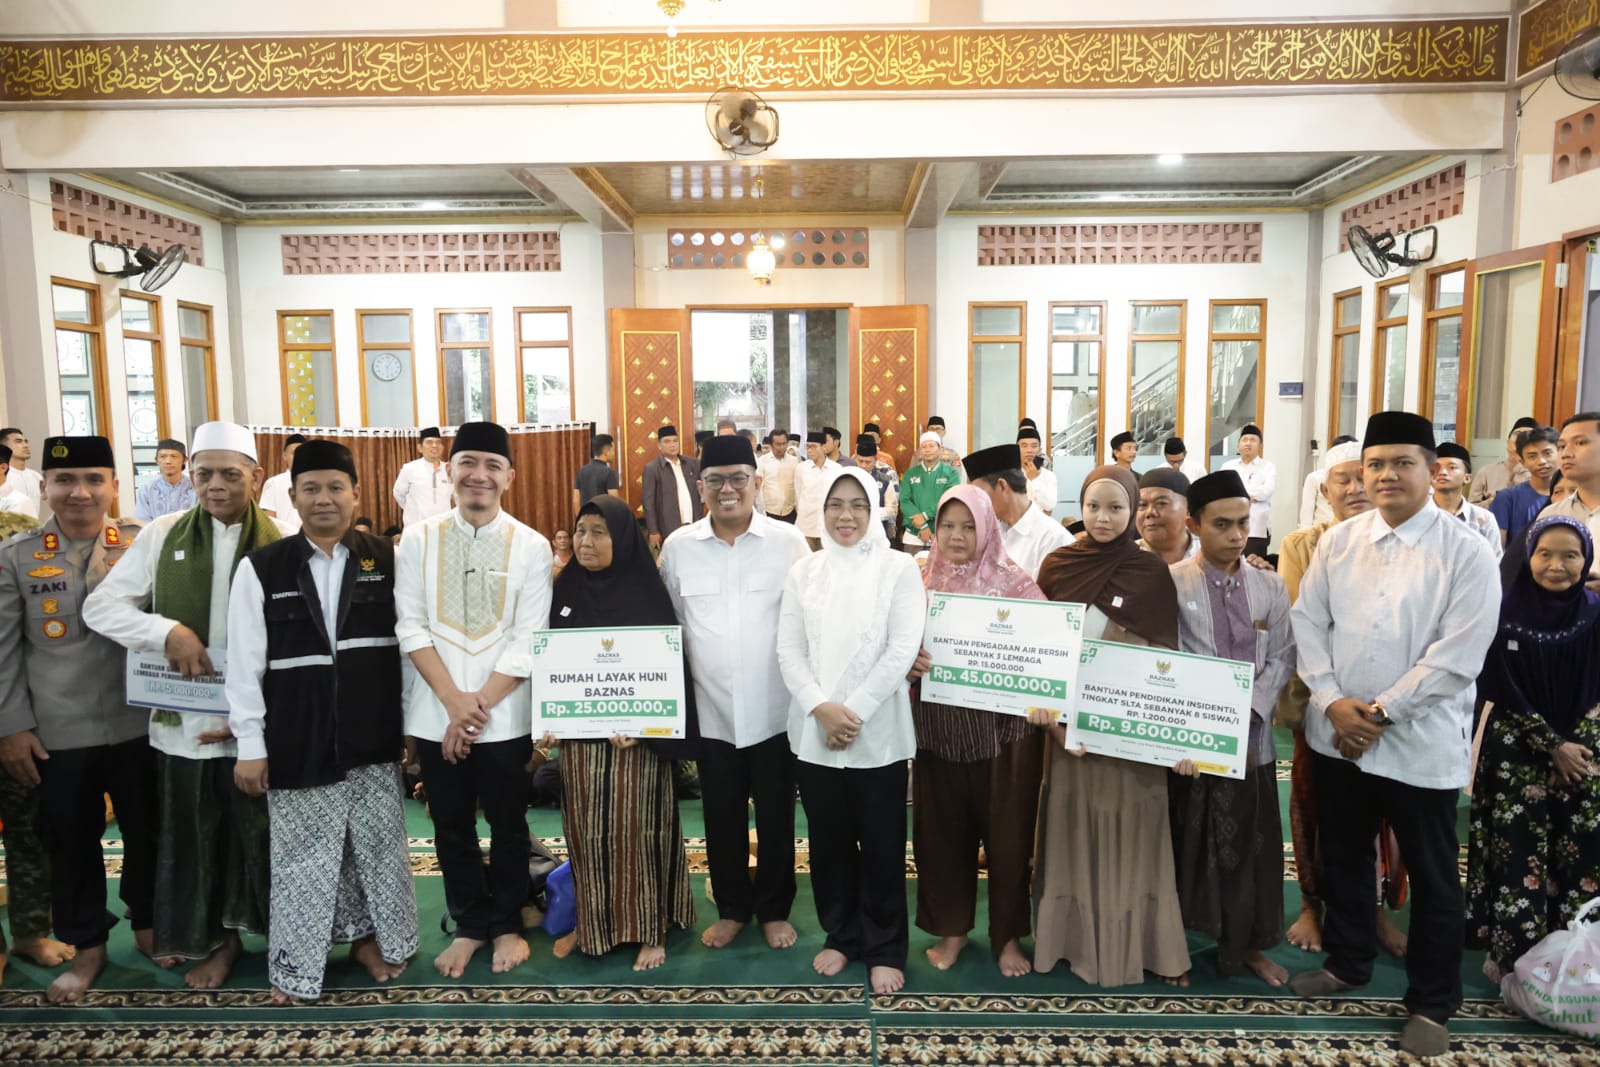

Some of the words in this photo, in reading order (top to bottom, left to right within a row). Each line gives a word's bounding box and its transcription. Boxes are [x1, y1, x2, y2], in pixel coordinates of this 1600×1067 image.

[29, 581, 66, 594] ZAKI
[933, 636, 969, 647] BANTUAN
[971, 640, 1020, 652] PENGADAAN
[1022, 646, 1036, 654] AIR
[1038, 647, 1069, 657] BERSIH
[953, 648, 994, 660] SEBANYAK
[1002, 654, 1042, 665] LEMBAGA
[981, 660, 1024, 673] 15.000.000
[550, 674, 593, 683] RUMAH
[597, 672, 636, 682] LAYAK
[639, 672, 668, 682] HUNI
[933, 667, 956, 682] Rp.
[959, 670, 1061, 696] 45.000.000,-
[585, 687, 635, 697] BAZNAS
[1084, 683, 1127, 697] BANTUAN
[1129, 690, 1184, 706] PENDIDIKAN
[1186, 700, 1238, 714] INSIDENTIL
[546, 702, 570, 717] Rp.
[574, 700, 673, 715] 25.000.000,-
[1081, 693, 1118, 705] TINGKAT
[1121, 699, 1141, 709] SLTA
[1143, 703, 1192, 718] SEBANYAK
[1202, 712, 1239, 725] SISWA/I
[1142, 713, 1186, 726] 1.200.000
[1088, 714, 1115, 731] Rp.
[1120, 719, 1226, 750] 9.600.000,-
